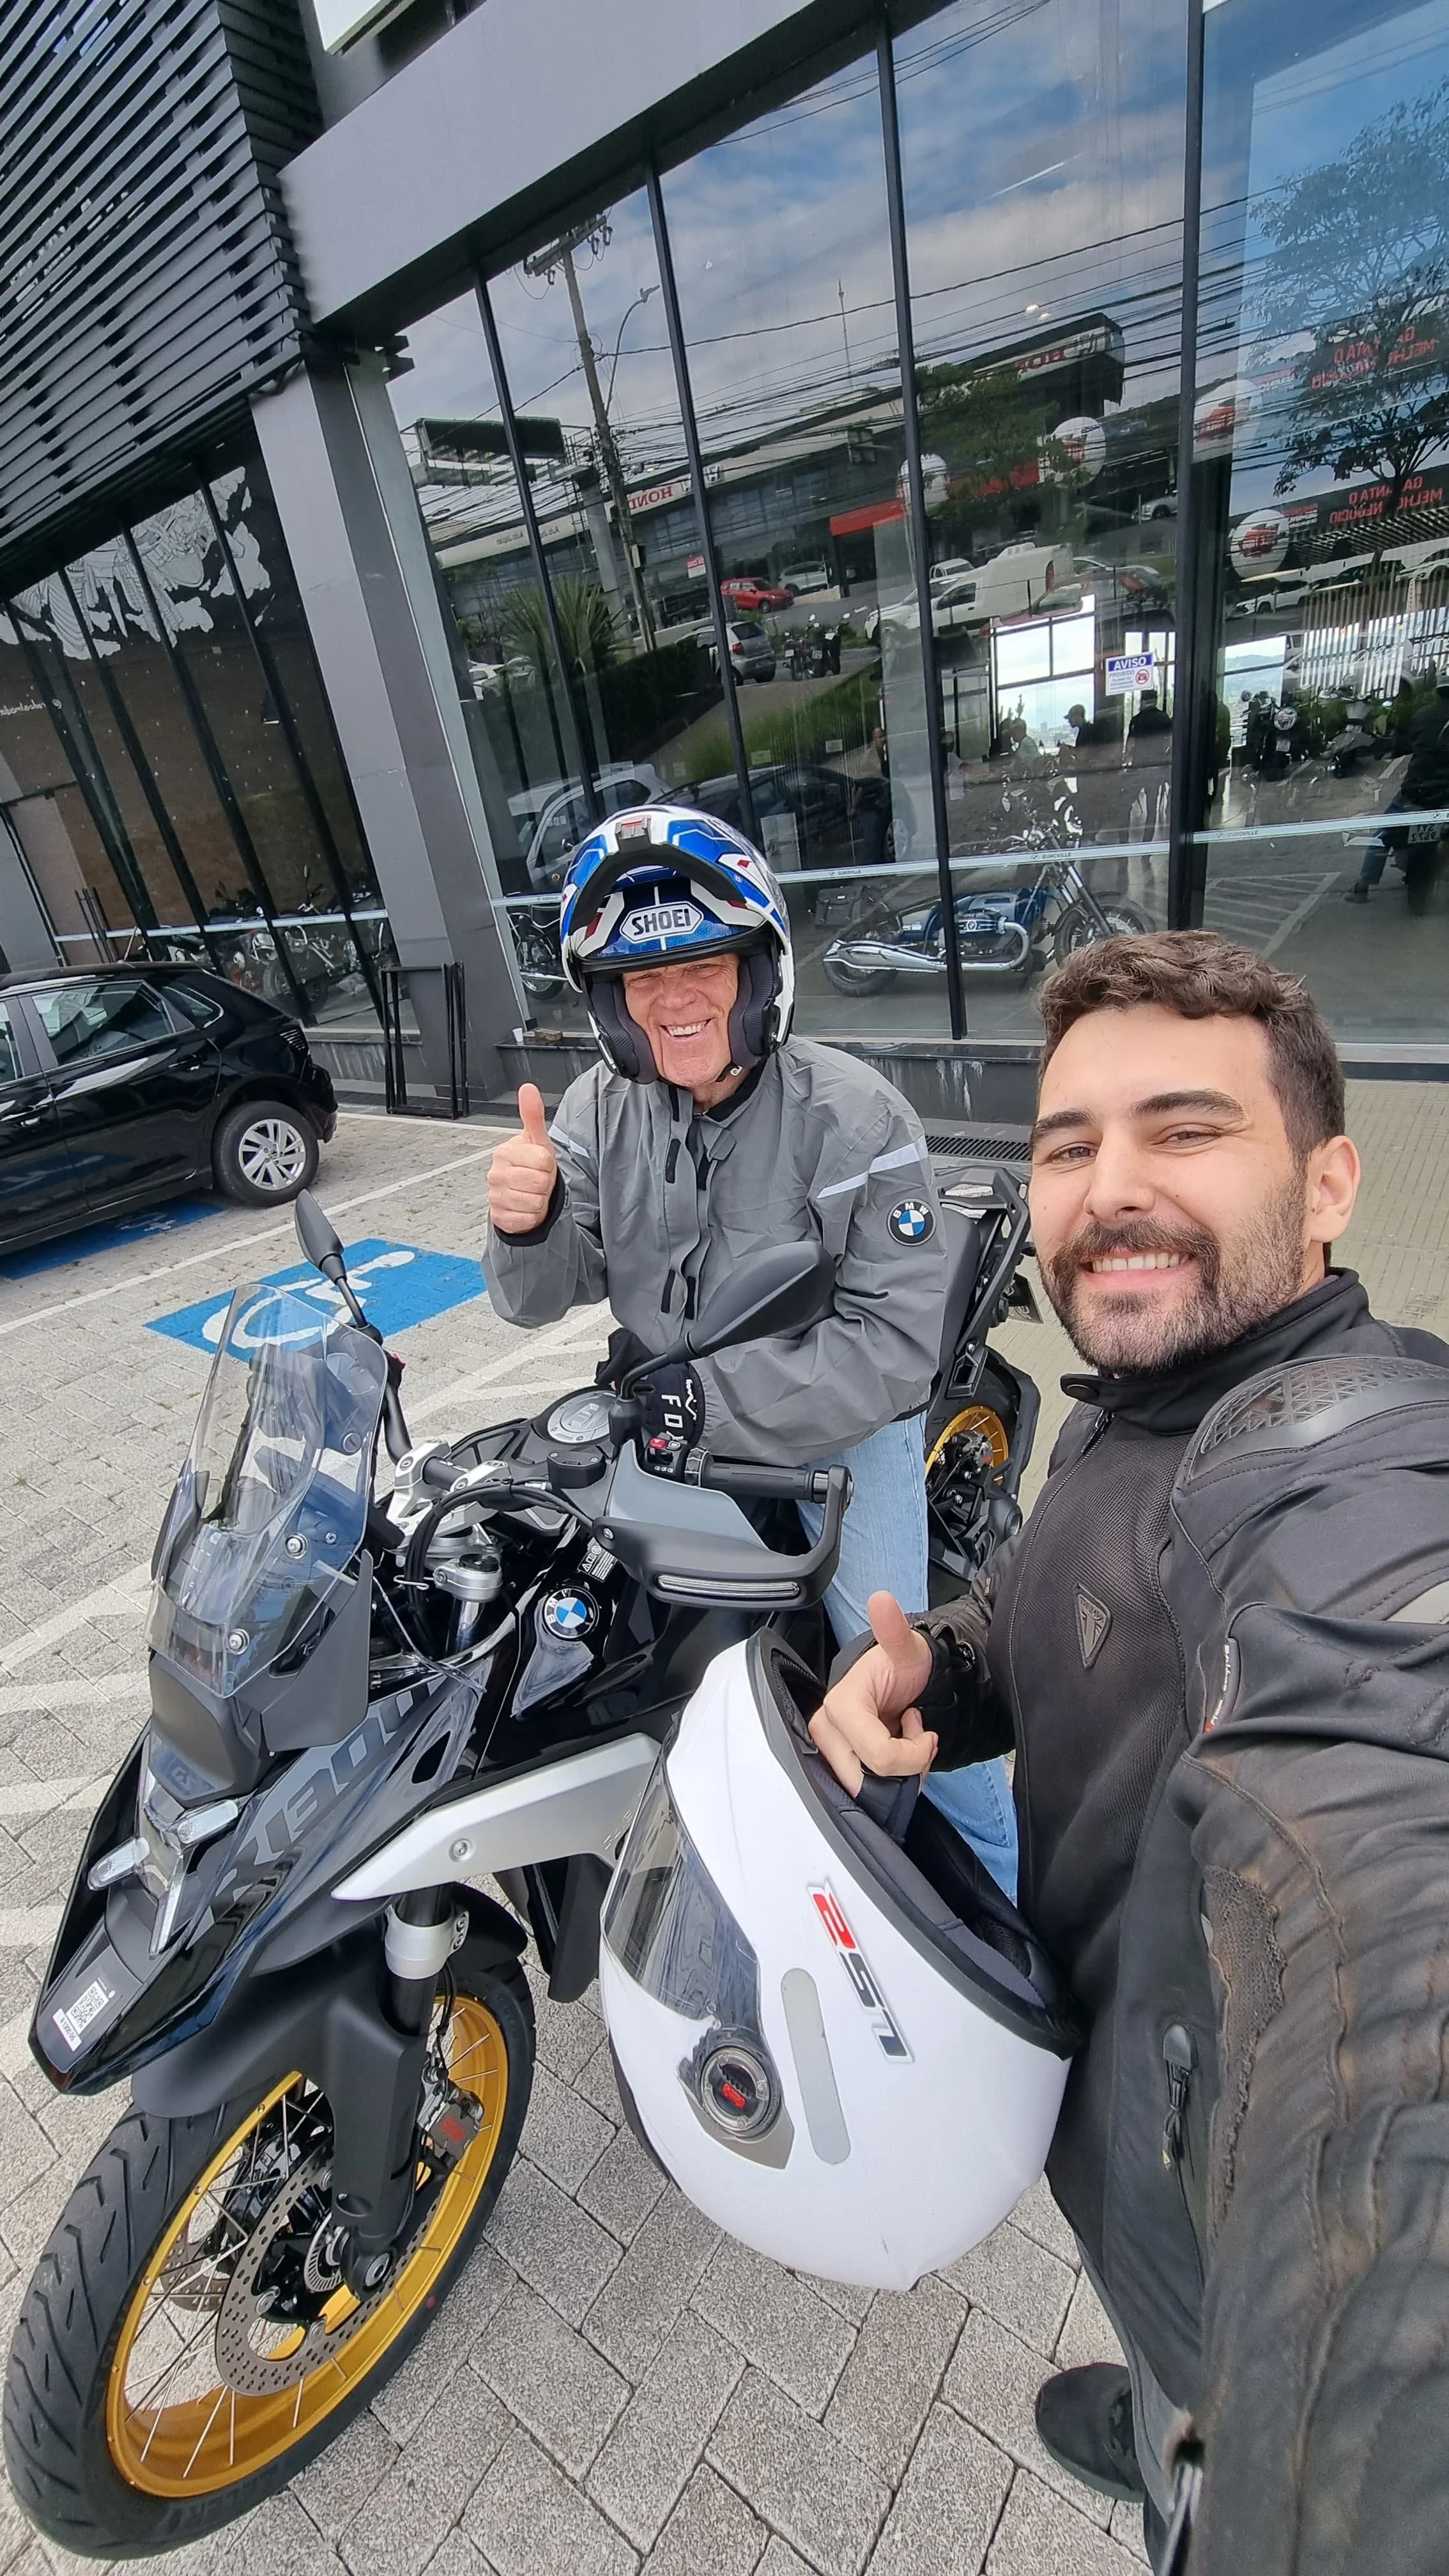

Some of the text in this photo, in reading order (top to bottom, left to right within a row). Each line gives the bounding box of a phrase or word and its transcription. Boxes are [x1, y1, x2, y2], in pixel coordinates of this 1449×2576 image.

[1114, 657, 1147, 671] AVISO
[631, 908, 691, 936] SHOEI
[893, 1202, 930, 1219] BMW
[546, 1589, 572, 1624] BMW
